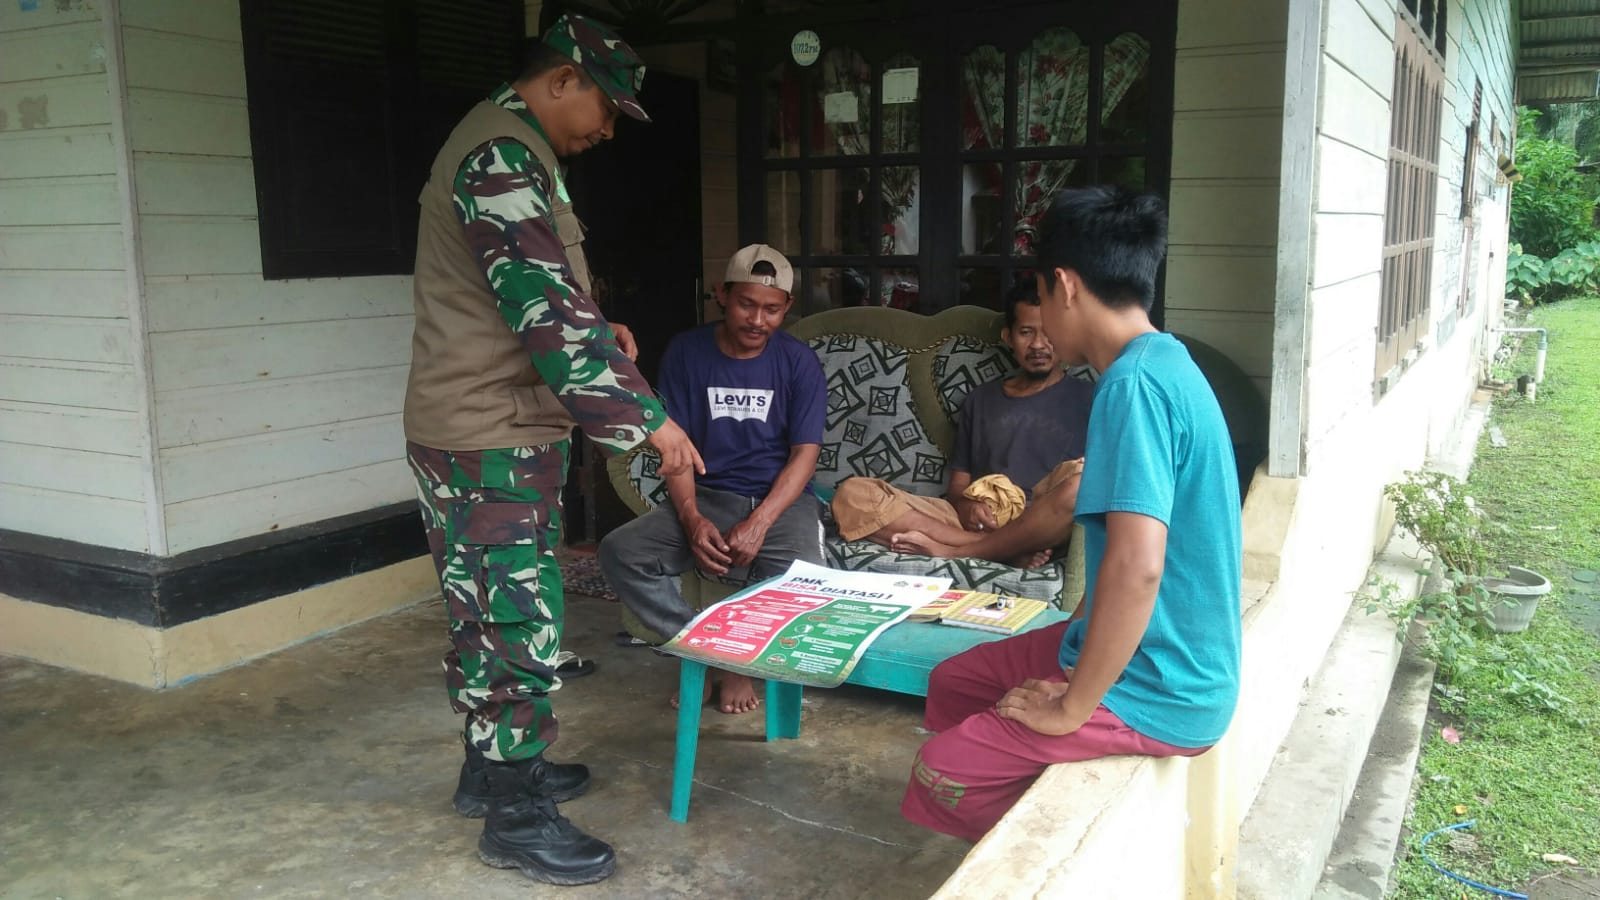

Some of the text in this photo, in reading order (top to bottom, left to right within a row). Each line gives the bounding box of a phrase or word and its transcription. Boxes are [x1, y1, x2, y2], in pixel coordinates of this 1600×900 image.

[715, 393, 766, 407] Levi's
[791, 576, 827, 586] PMK
[781, 582, 817, 591] BISA
